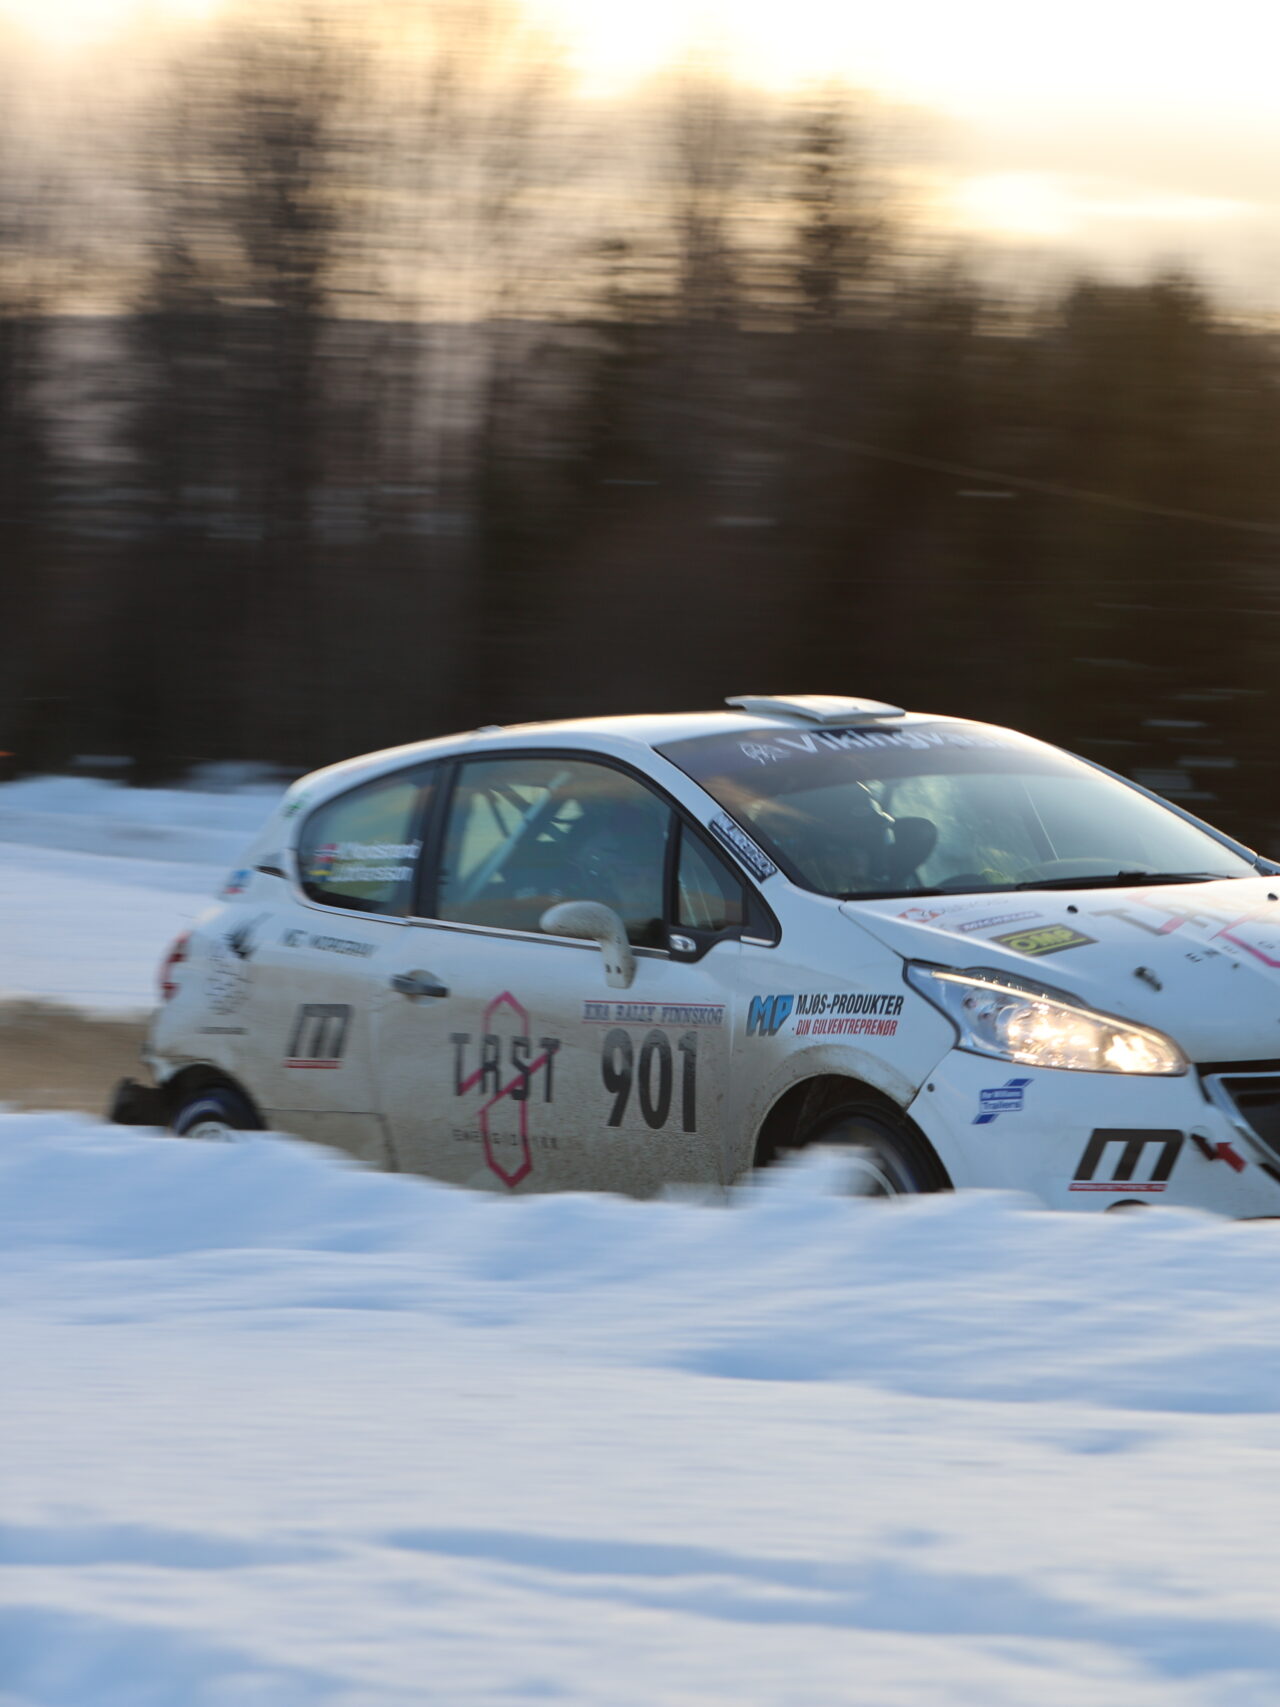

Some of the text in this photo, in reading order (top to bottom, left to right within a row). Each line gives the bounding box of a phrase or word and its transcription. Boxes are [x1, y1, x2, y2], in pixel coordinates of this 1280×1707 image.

[1009, 929, 1073, 950] OMP
[796, 994, 904, 1015] MJØS-PRODUKTER
[662, 1007, 724, 1024] FINNSKOG
[747, 995, 794, 1036] MP
[796, 1019, 898, 1036] DIN GULVENTREPRENØR
[602, 1028, 698, 1132] 901
